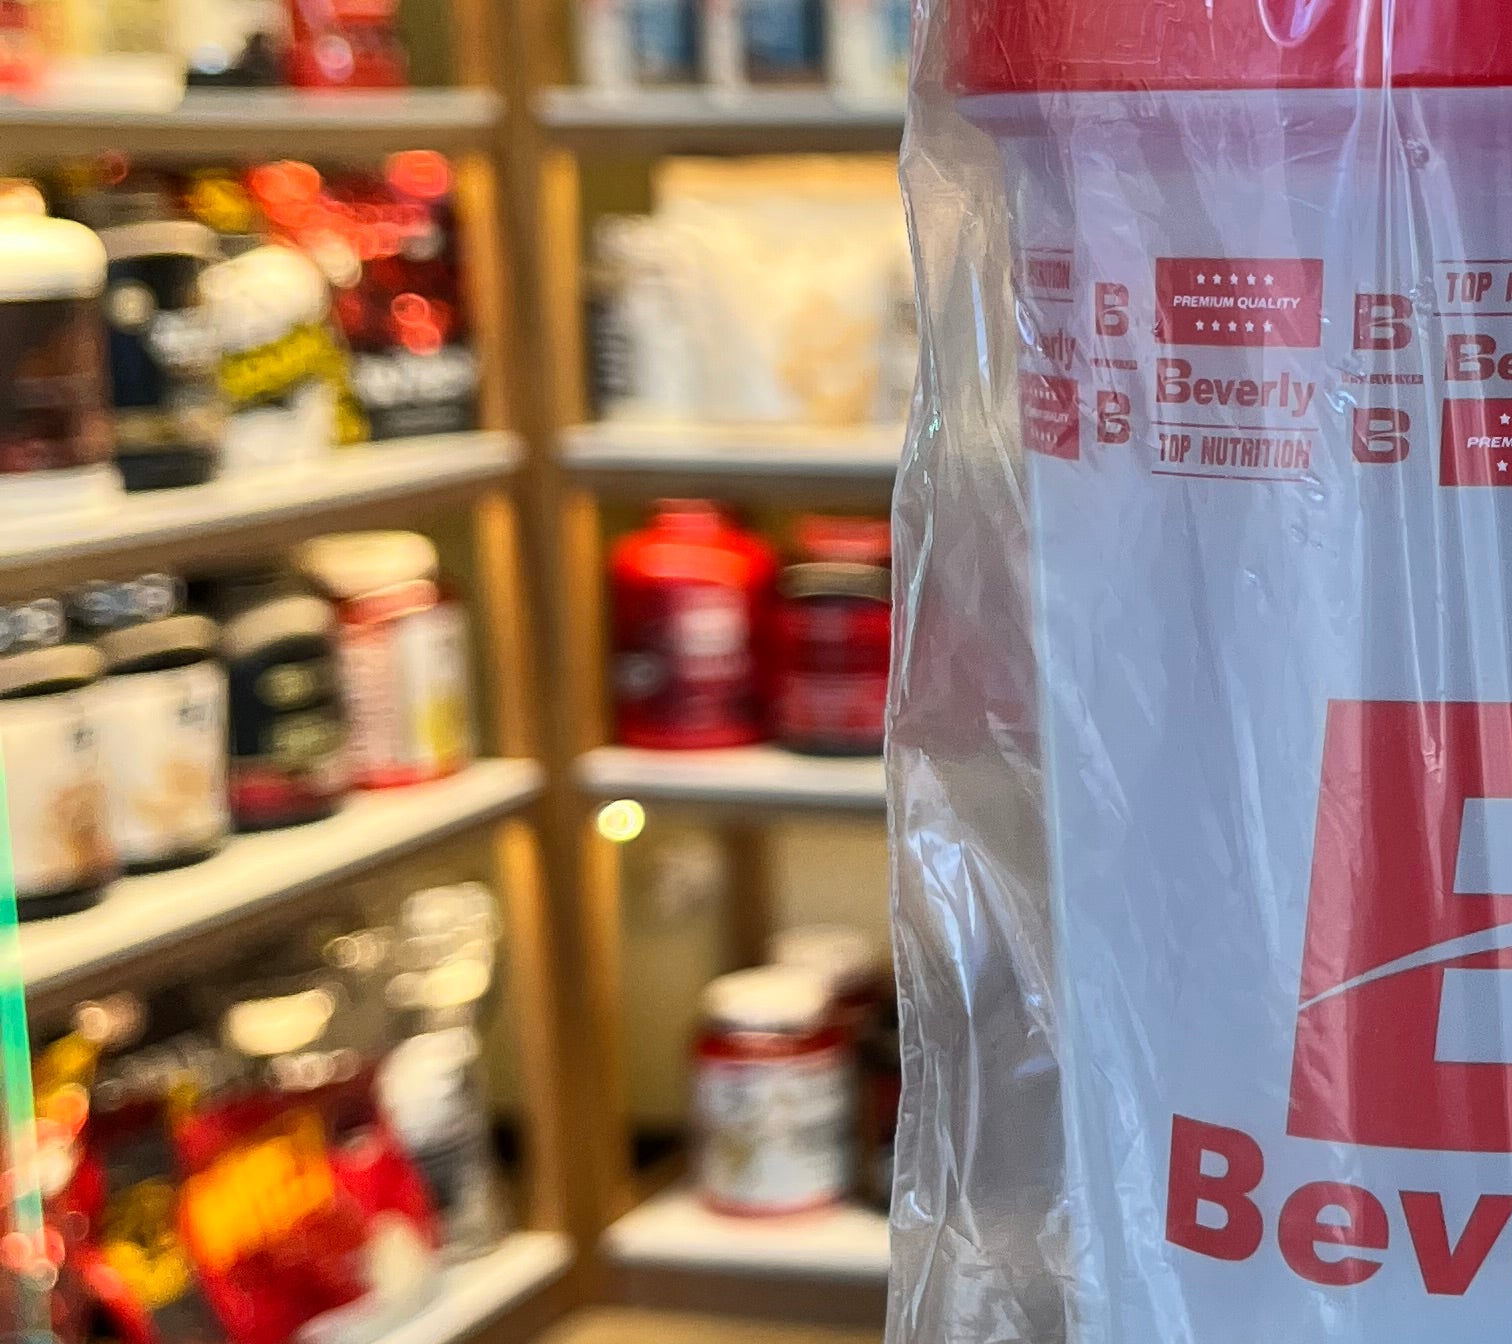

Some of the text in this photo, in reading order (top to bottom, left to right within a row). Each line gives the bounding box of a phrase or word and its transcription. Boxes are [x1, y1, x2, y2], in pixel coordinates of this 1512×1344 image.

[1173, 295, 1301, 310] PREMIUM QUALITY
[1446, 271, 1492, 303] TOP
[1354, 293, 1412, 351] B
[1156, 358, 1315, 416] Beverly
[1159, 433, 1312, 469] TOP NUTRITION
[1351, 407, 1411, 464] B
